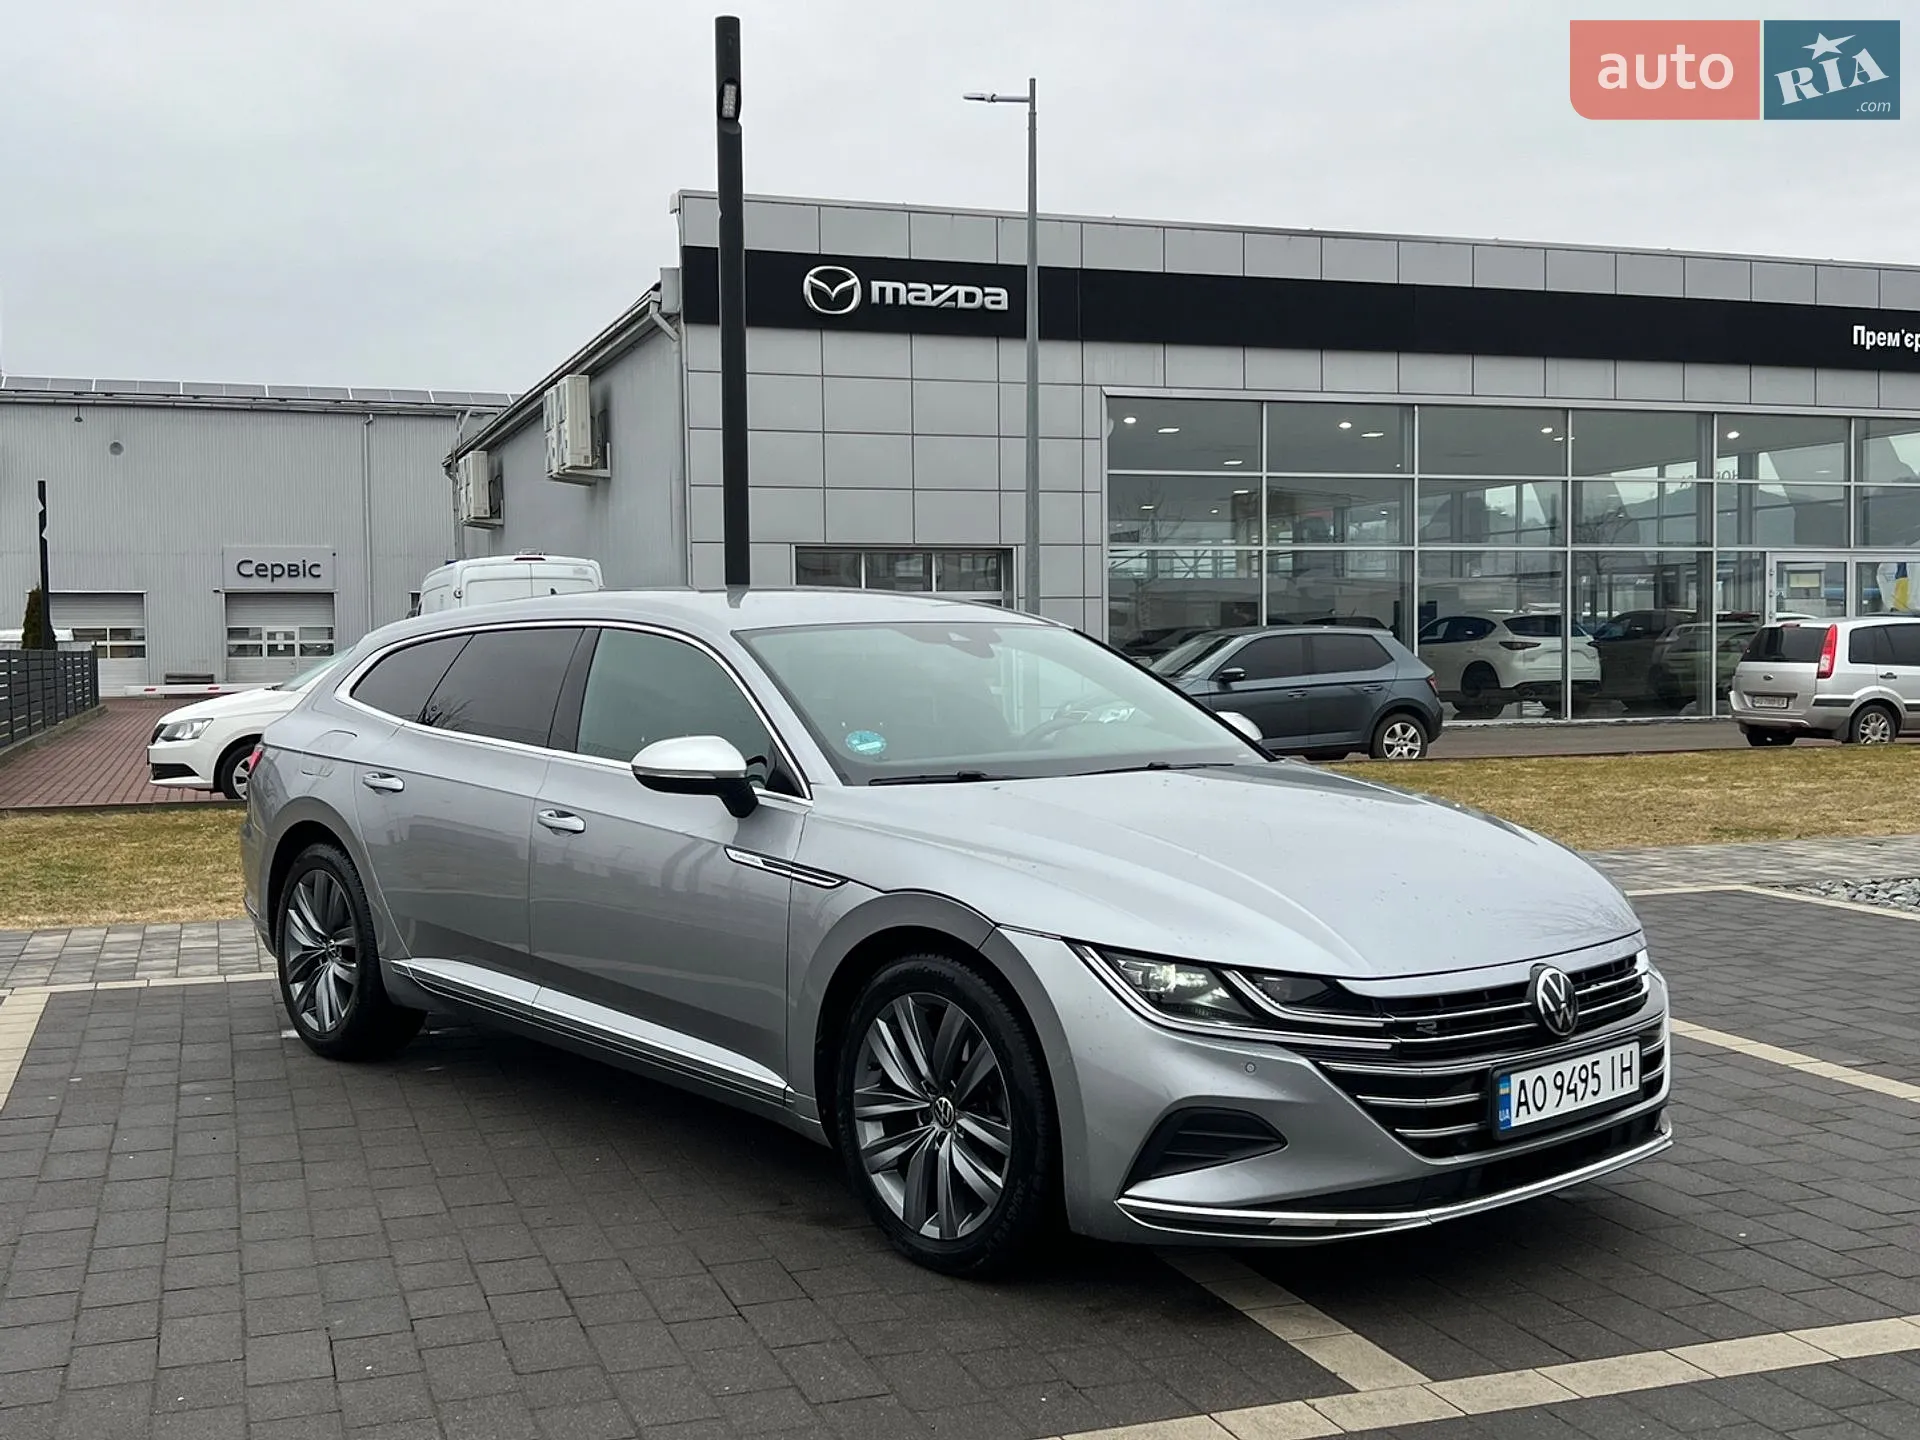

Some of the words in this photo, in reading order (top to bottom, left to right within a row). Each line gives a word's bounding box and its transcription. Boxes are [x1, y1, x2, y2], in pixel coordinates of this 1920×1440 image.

[870, 280, 1009, 311] mazda
[236, 559, 322, 583] Сервіс
[1515, 1075, 1547, 1118] AO
[1553, 1060, 1601, 1108] 9495
[1610, 1050, 1633, 1092] IH
[1499, 1108, 1511, 1121] UA
